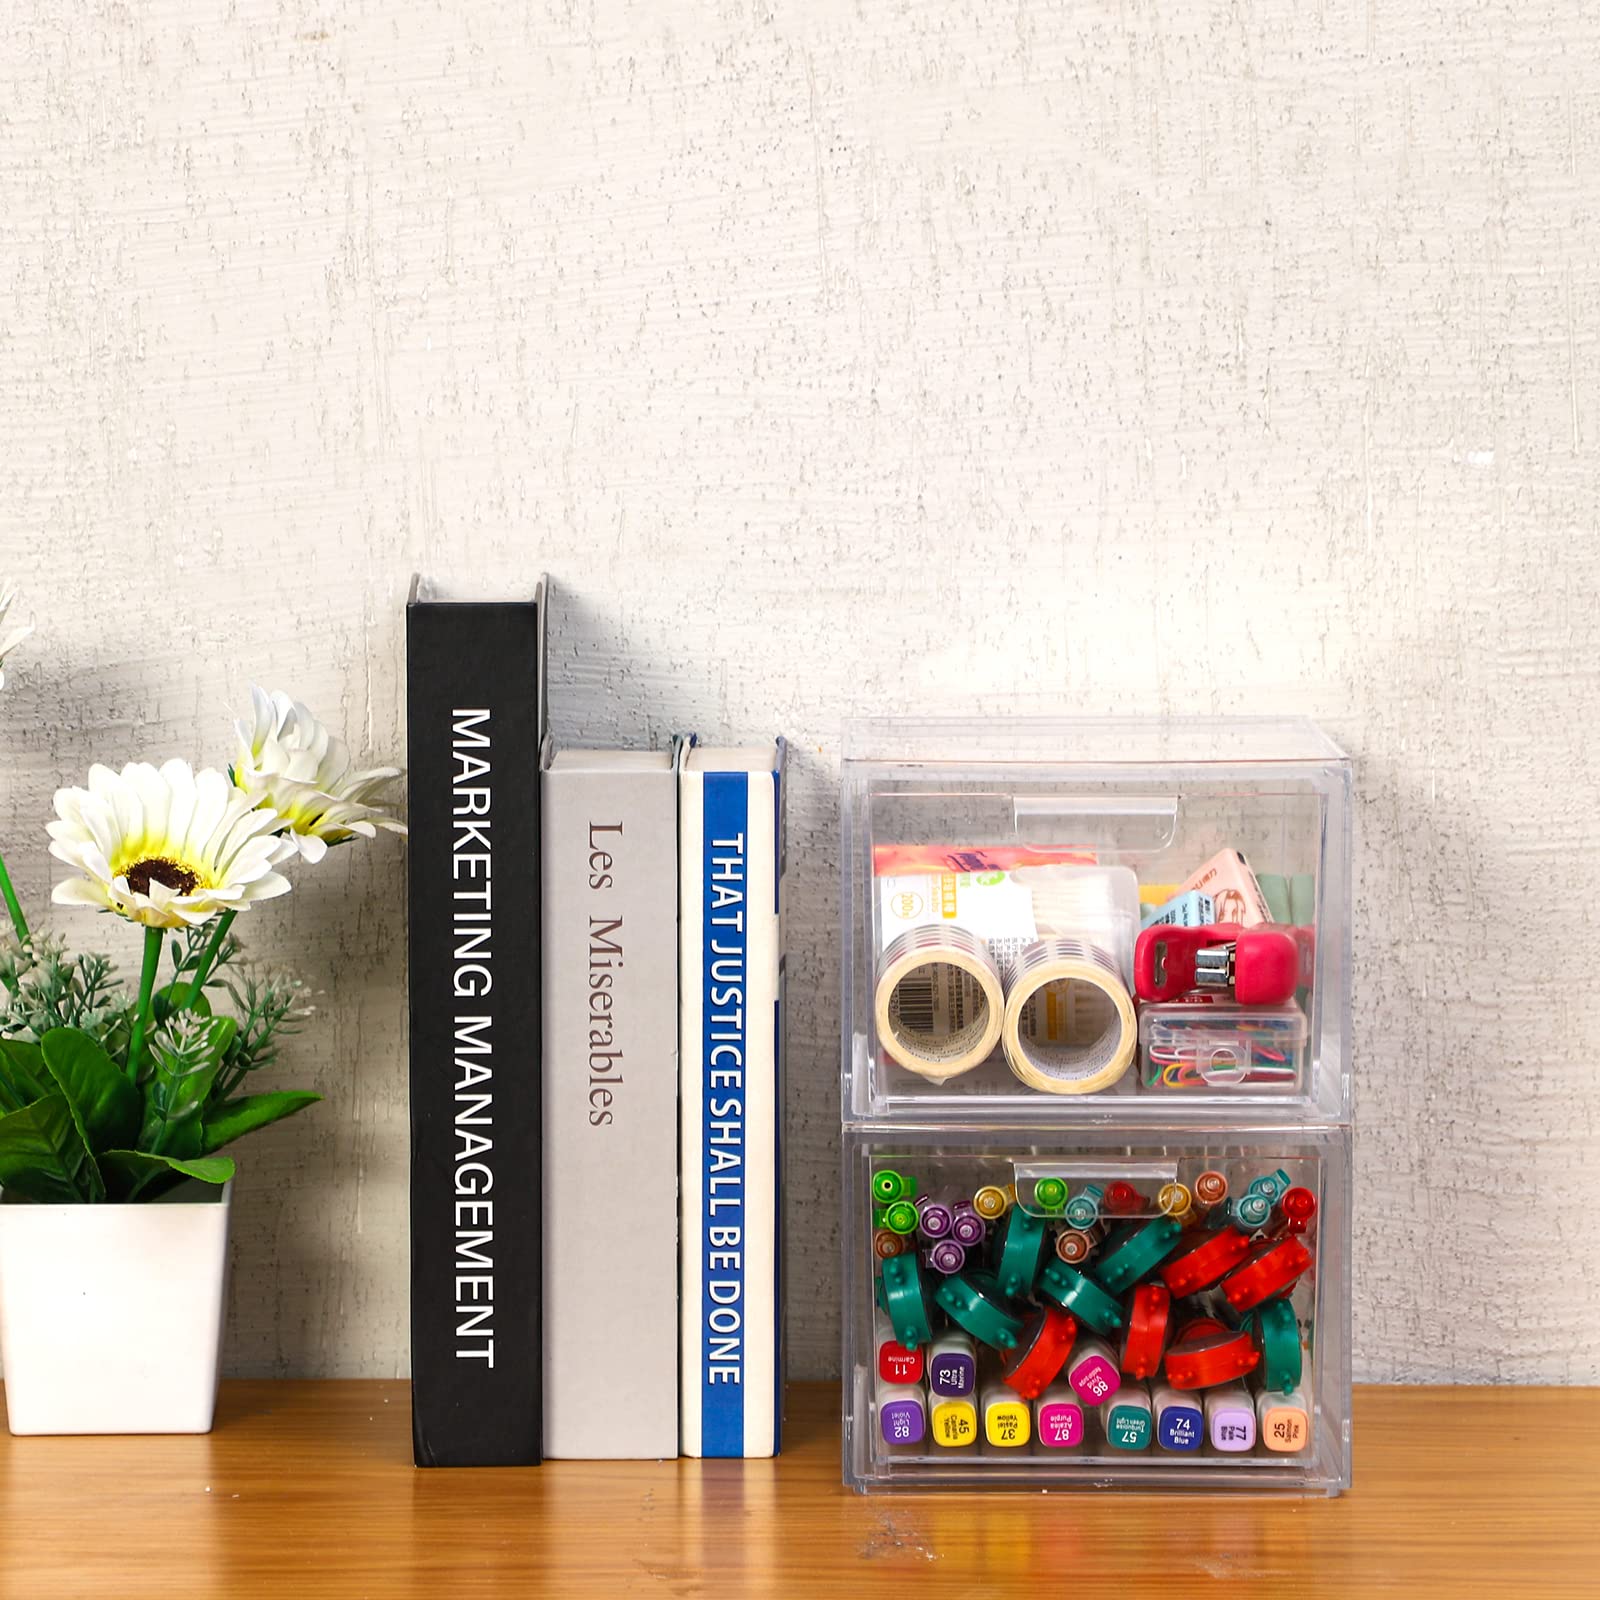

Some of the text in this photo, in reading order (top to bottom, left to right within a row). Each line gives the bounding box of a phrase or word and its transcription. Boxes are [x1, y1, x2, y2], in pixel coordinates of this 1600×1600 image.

[588, 821, 625, 1127] Les Miserables
[452, 708, 496, 1369] MARKETING MANAGEMENT
[708, 832, 746, 1385] THAT JUSTICE SHALL BE DONE
[888, 1356, 915, 1365] Carmine
[894, 1364, 908, 1375] 11
[939, 1369, 951, 1385] 73
[950, 1369, 958, 1386] Ultra
[957, 1366, 965, 1389] Marine
[1092, 1380, 1108, 1397] 86
[891, 1412, 911, 1420] Violet
[1050, 1414, 1072, 1422] Purple
[1116, 1416, 1146, 1428] Green Light
[893, 1419, 910, 1429] Light
[943, 1417, 951, 1438] Yellow
[959, 1419, 970, 1434] 45
[997, 1422, 1018, 1430] Pastel
[1050, 1421, 1073, 1430] Azalea
[1176, 1418, 1191, 1431] 74
[1273, 1422, 1285, 1438] 25
[894, 1427, 910, 1438] 82
[1001, 1429, 1016, 1440] 37
[1054, 1429, 1070, 1441] 87
[1121, 1431, 1138, 1443] 57
[1169, 1429, 1195, 1438] Brilliant
[1220, 1426, 1228, 1440] Blue
[1236, 1425, 1247, 1441] 77
[1284, 1418, 1293, 1444] Salmon
[1292, 1424, 1300, 1439] Pink
[1174, 1436, 1190, 1445] Blue
